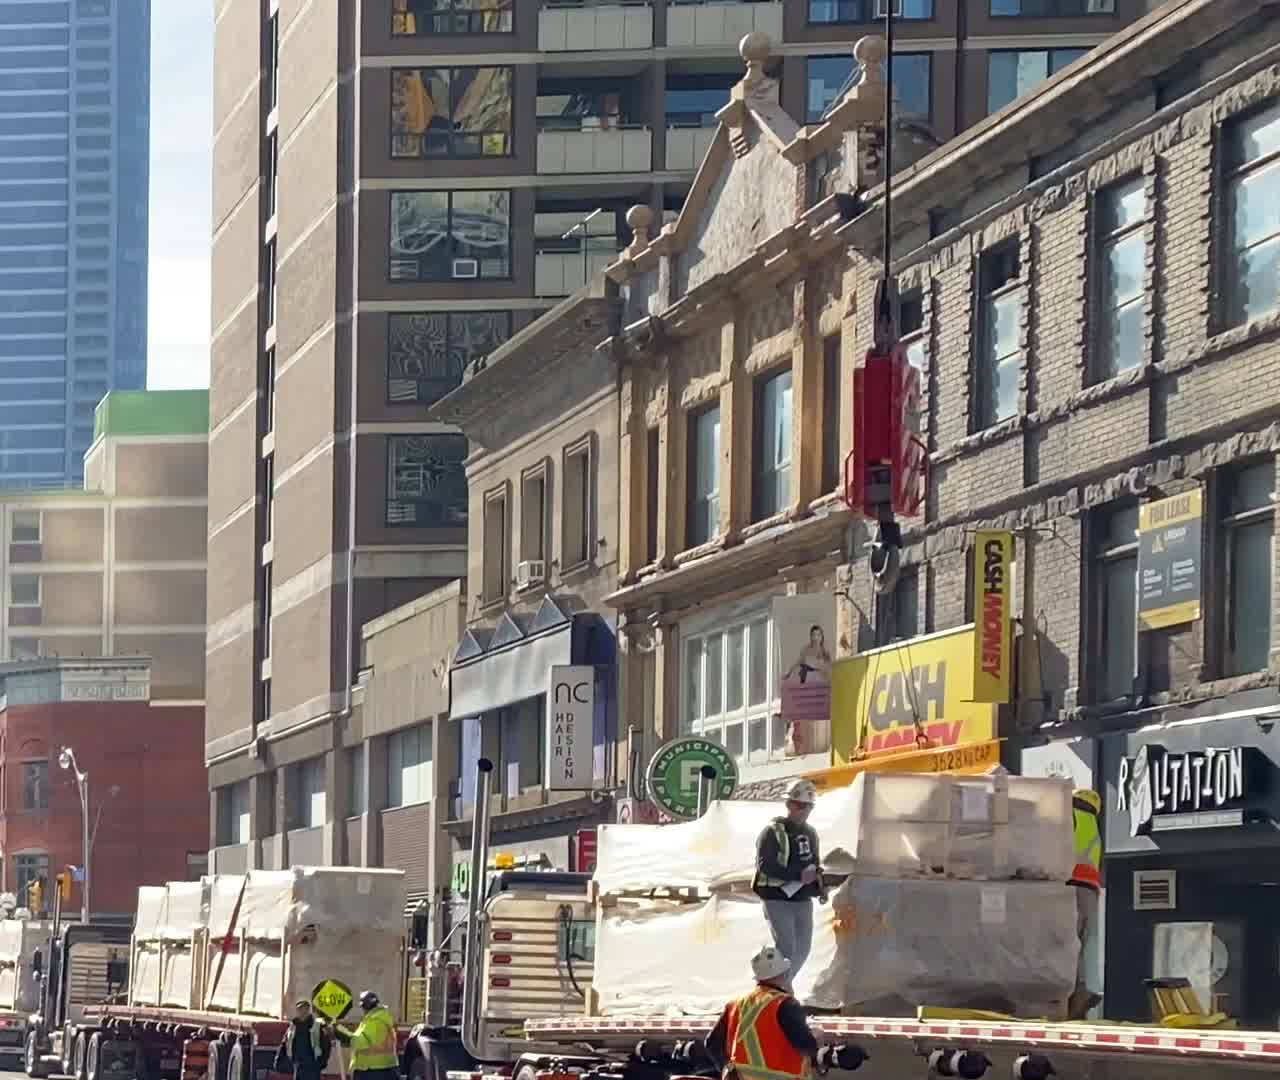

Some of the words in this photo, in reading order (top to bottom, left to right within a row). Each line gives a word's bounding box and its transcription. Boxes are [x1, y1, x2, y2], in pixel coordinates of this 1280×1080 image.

[984, 539, 1003, 593] CASH
[982, 592, 1003, 680] MONEY
[870, 660, 947, 732] CASH
[555, 712, 564, 757] HAIR
[565, 712, 574, 779] DESIGN
[657, 742, 732, 770] MUNICIPAL
[319, 993, 346, 1007] SLOW
